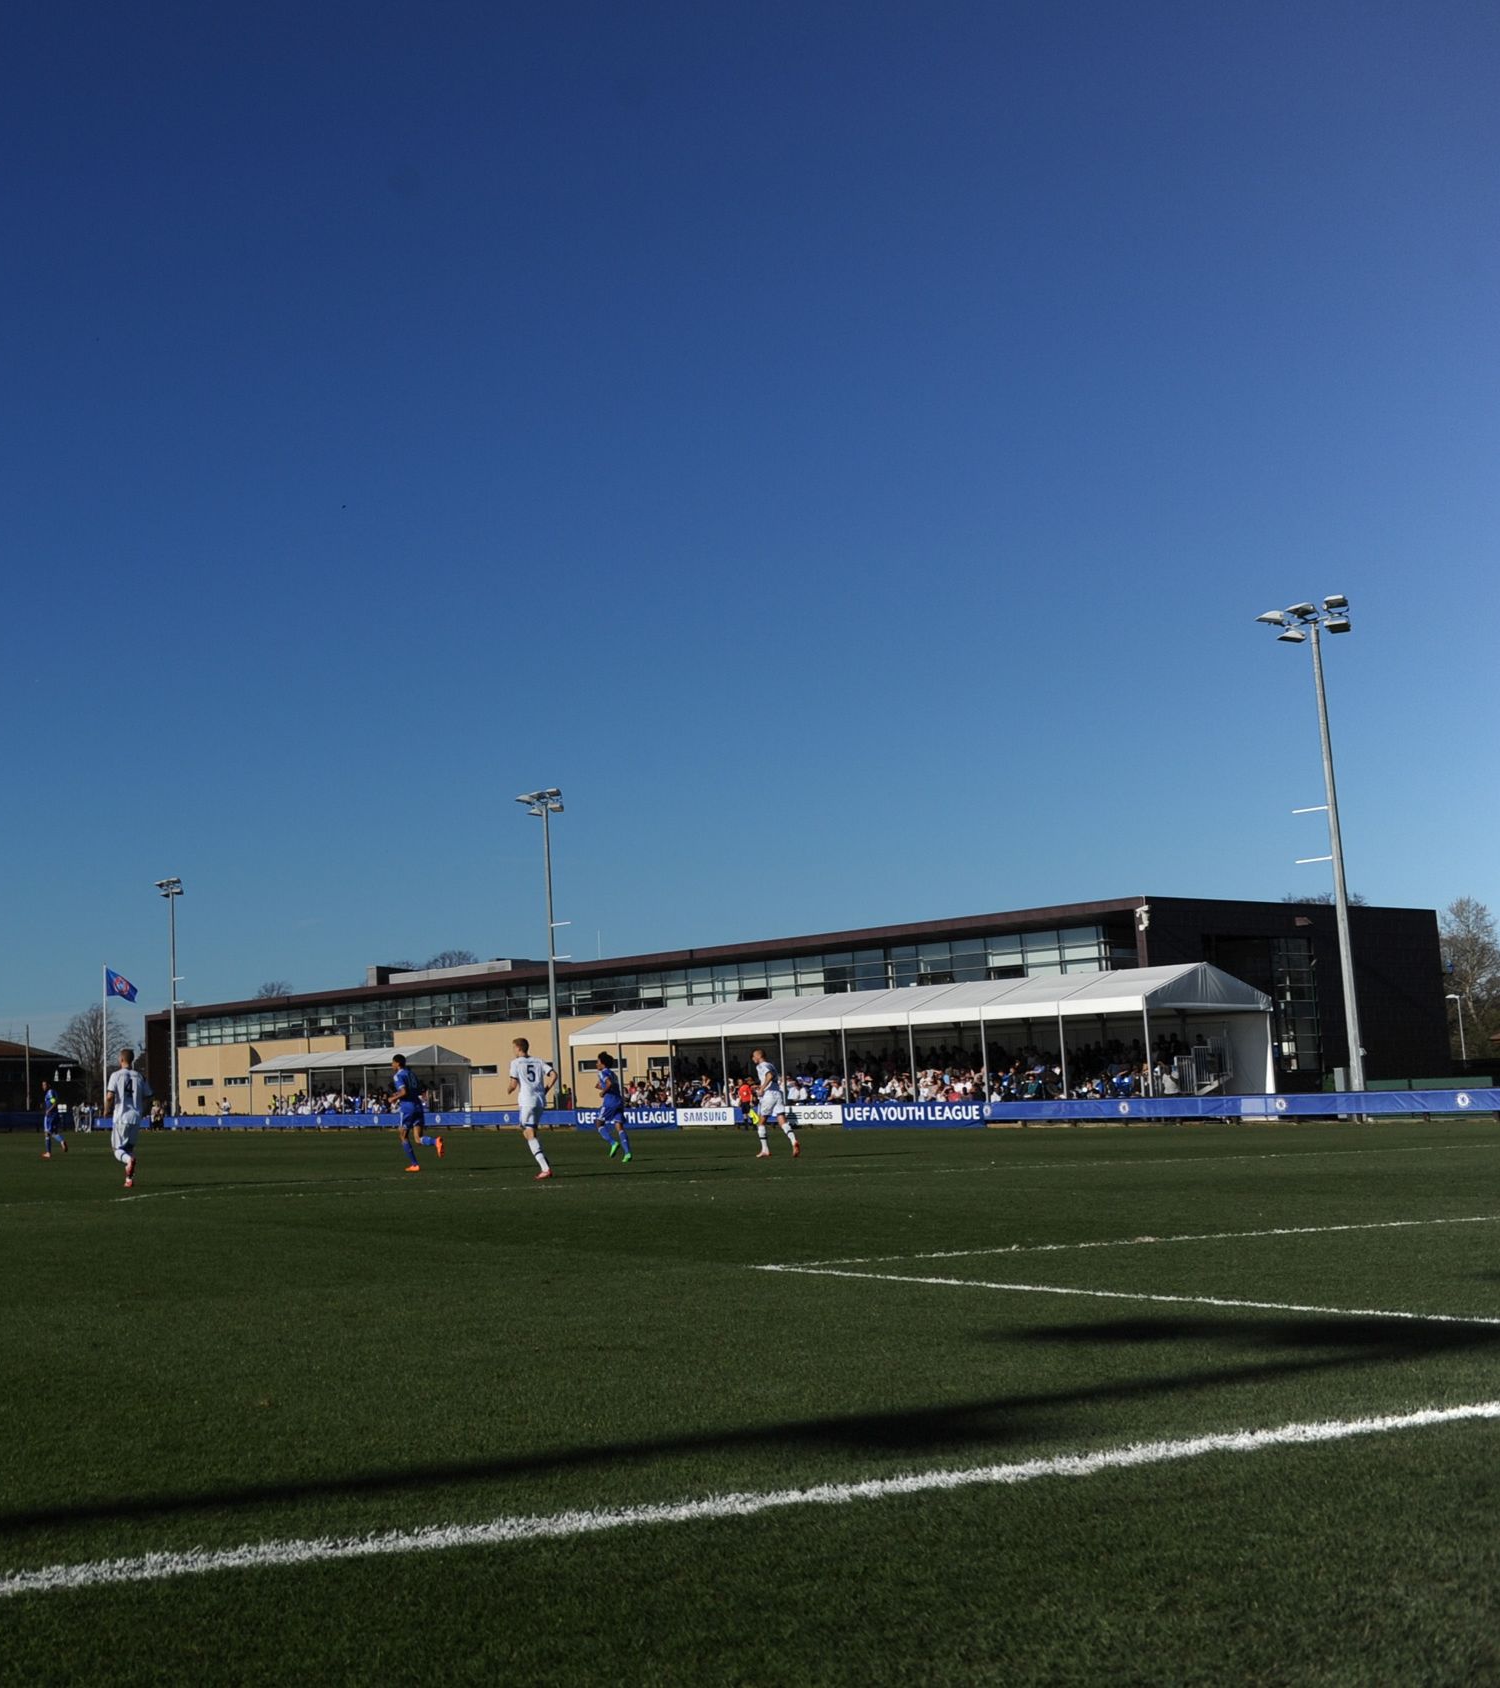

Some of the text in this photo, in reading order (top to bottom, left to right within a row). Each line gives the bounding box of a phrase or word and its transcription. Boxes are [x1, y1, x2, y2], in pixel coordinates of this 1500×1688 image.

[526, 1064, 536, 1082] 5
[124, 1078, 134, 1097] 4
[577, 1111, 599, 1124] UEF
[637, 1110, 675, 1124] LEAGUE
[684, 1112, 727, 1122] SAMSUNG
[804, 1109, 833, 1120] adidas
[844, 1105, 980, 1121] UEFA YOUTH LEAGUE
